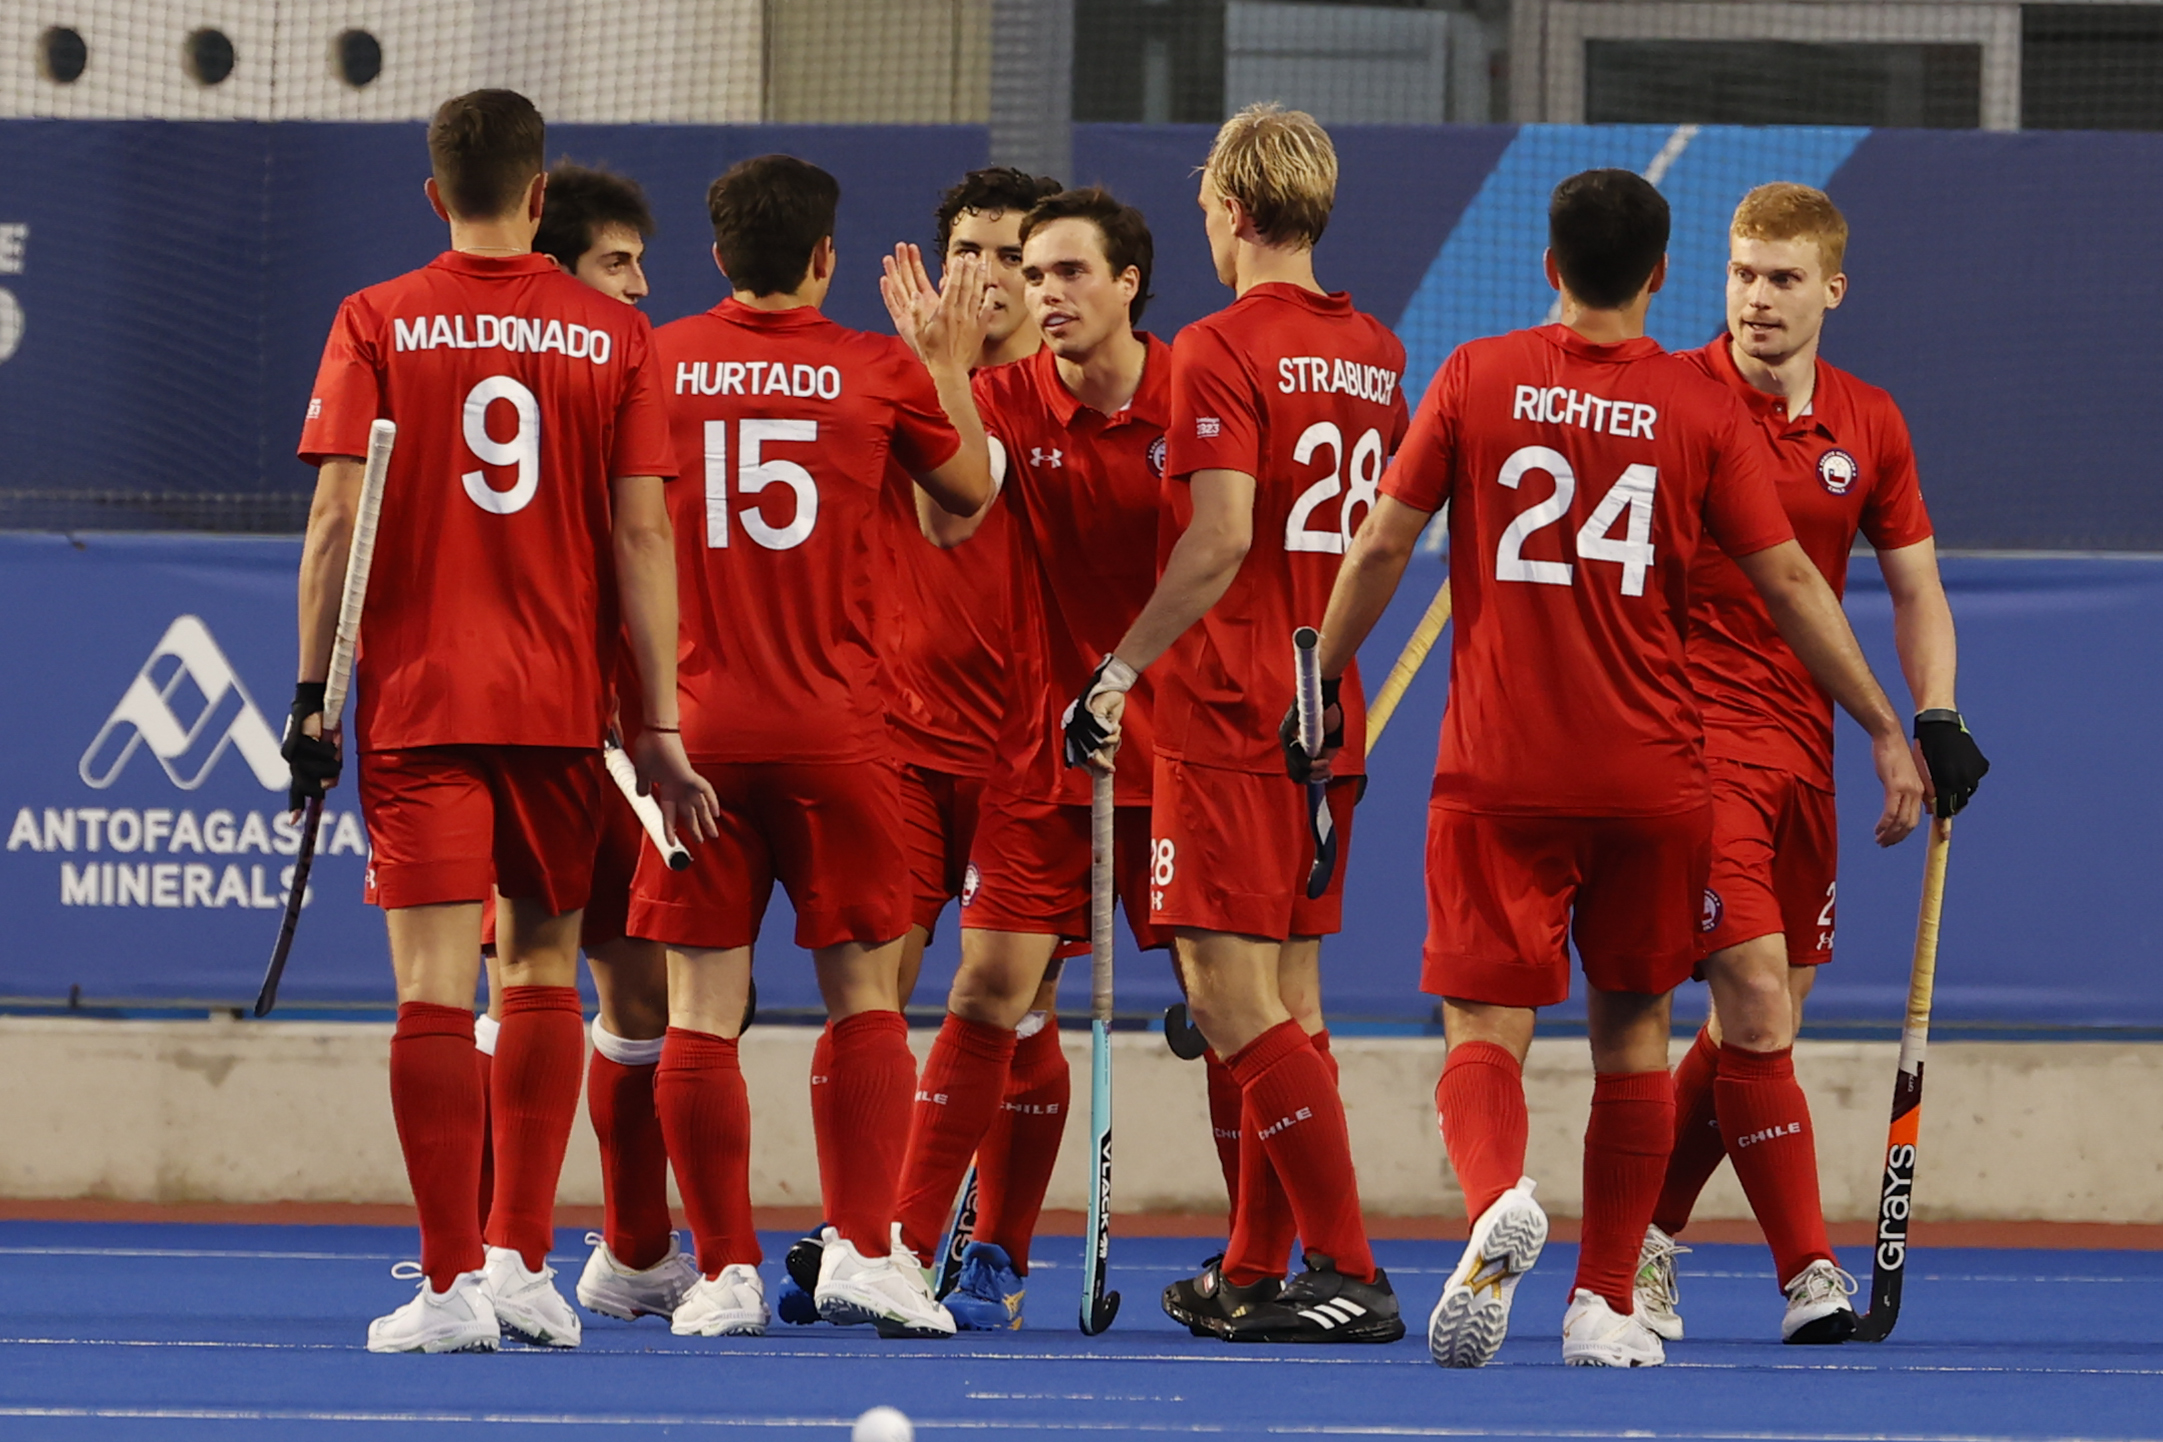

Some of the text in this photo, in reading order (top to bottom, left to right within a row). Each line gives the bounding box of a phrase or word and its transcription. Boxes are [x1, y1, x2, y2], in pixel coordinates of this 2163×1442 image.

[394, 314, 611, 365] MALDONADO
[675, 361, 841, 399] HURTADO
[1513, 384, 1657, 440] RICHTER
[461, 375, 540, 514] 9
[704, 418, 818, 550] 15
[1284, 421, 1382, 554] 28
[1495, 445, 1658, 597] 24
[7, 807, 366, 856] ANTOFAGASTA
[60, 862, 314, 908] MINERALS
[915, 1091, 949, 1105] ILE
[1215, 1127, 1242, 1139] CHI
[1258, 1106, 1313, 1141] CHILE
[1738, 1121, 1801, 1148] CHILE
[1100, 1140, 1112, 1231] VLACK
